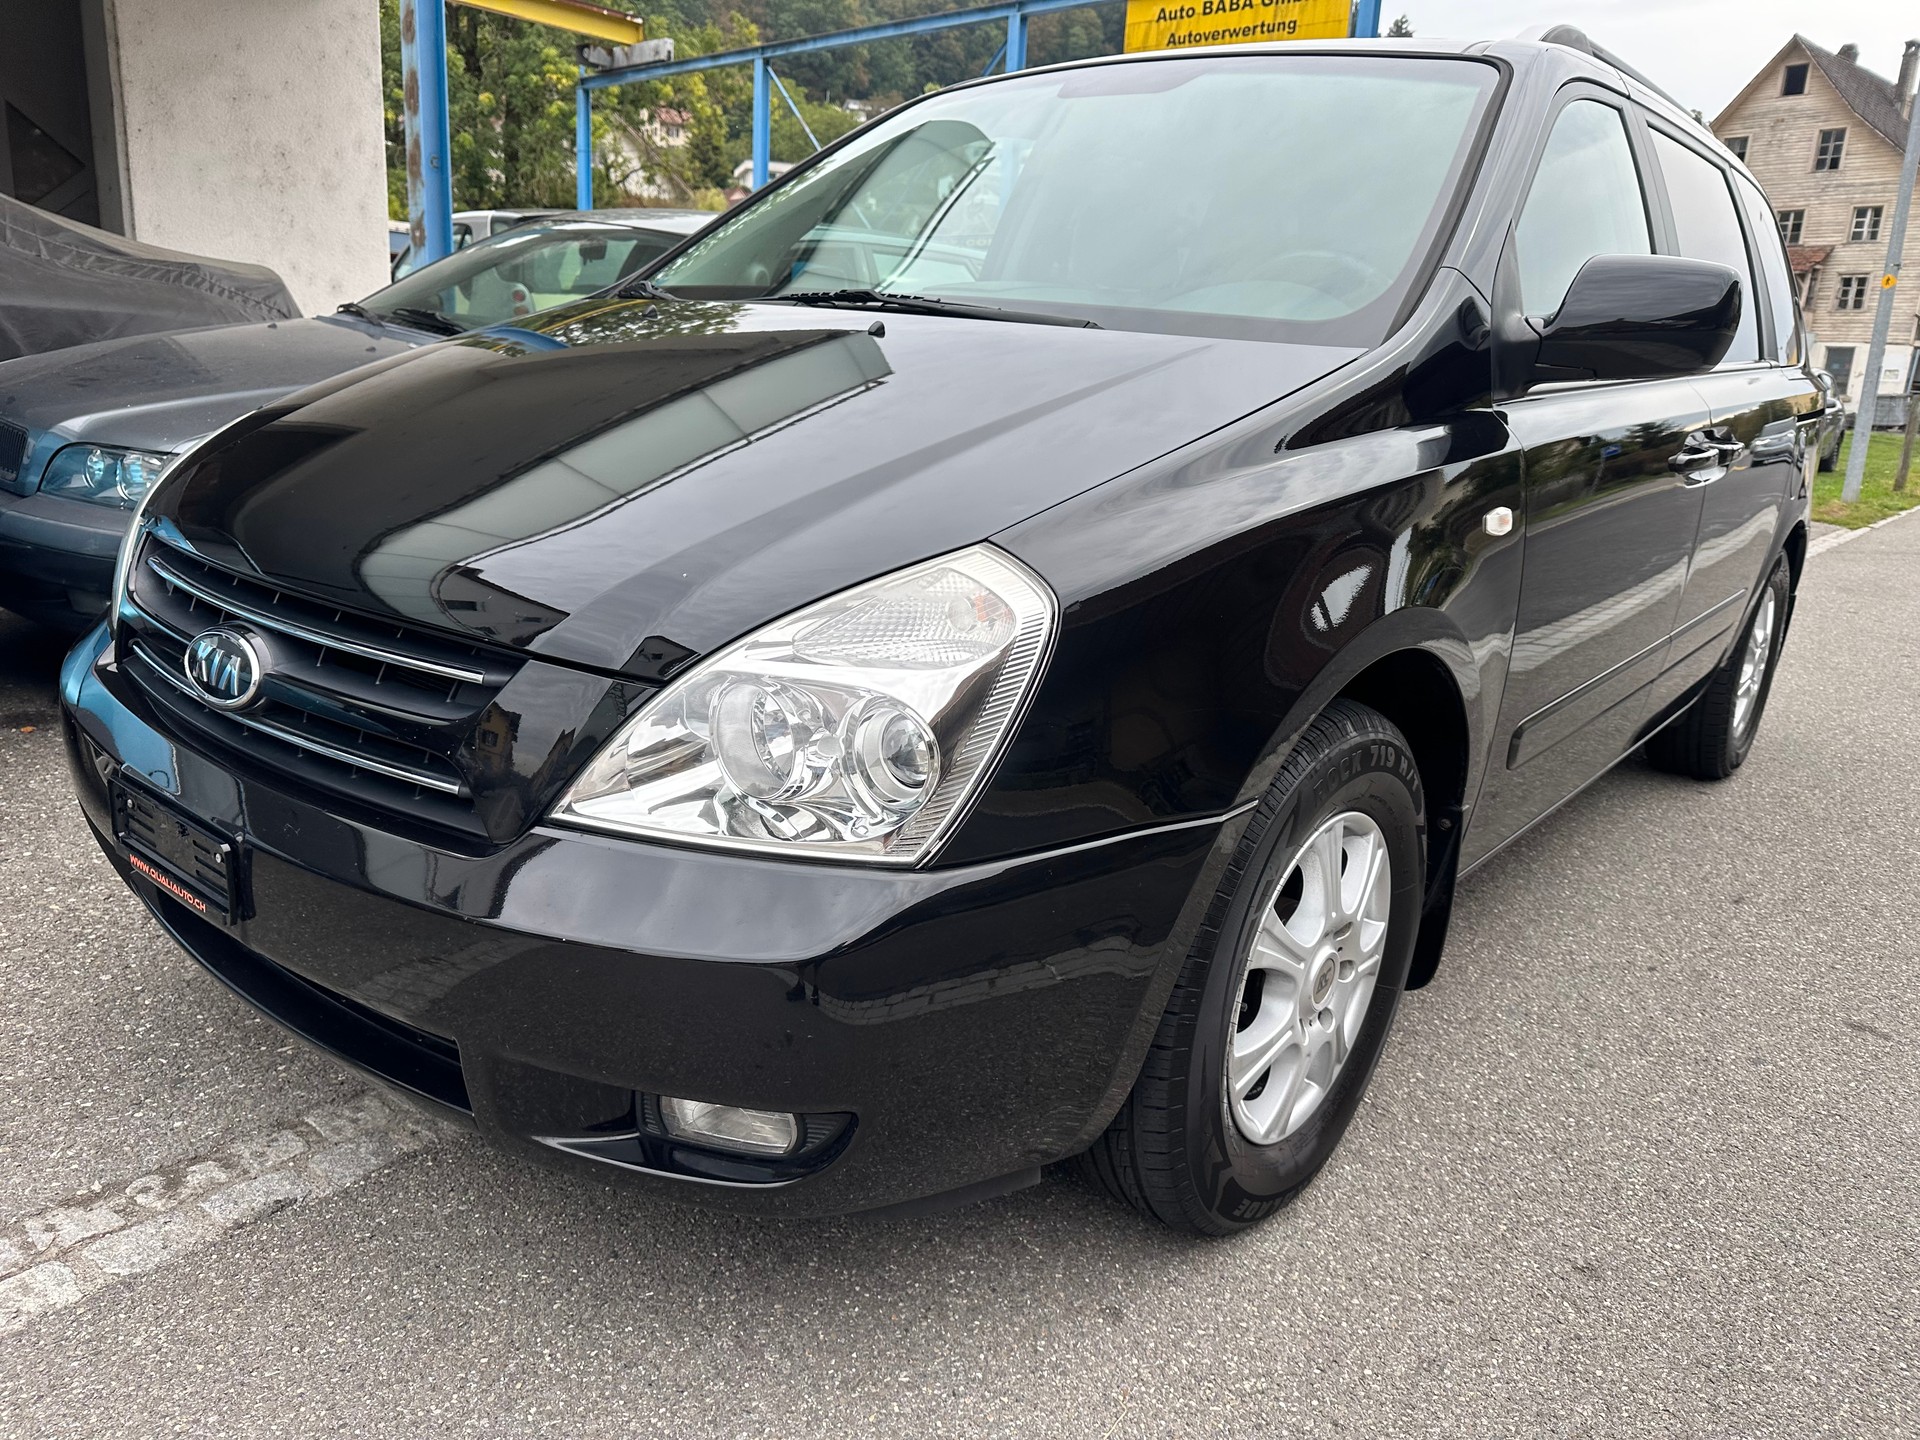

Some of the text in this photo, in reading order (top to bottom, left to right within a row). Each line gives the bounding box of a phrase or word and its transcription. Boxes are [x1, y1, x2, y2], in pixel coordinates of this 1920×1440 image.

[1155, 7, 1195, 23] Auto
[1201, 0, 1255, 15] BABA
[1166, 18, 1298, 47] Autoverwertung
[1370, 745, 1395, 768] 719
[129, 854, 206, 913] WWW.QUALIAUTO.CH
